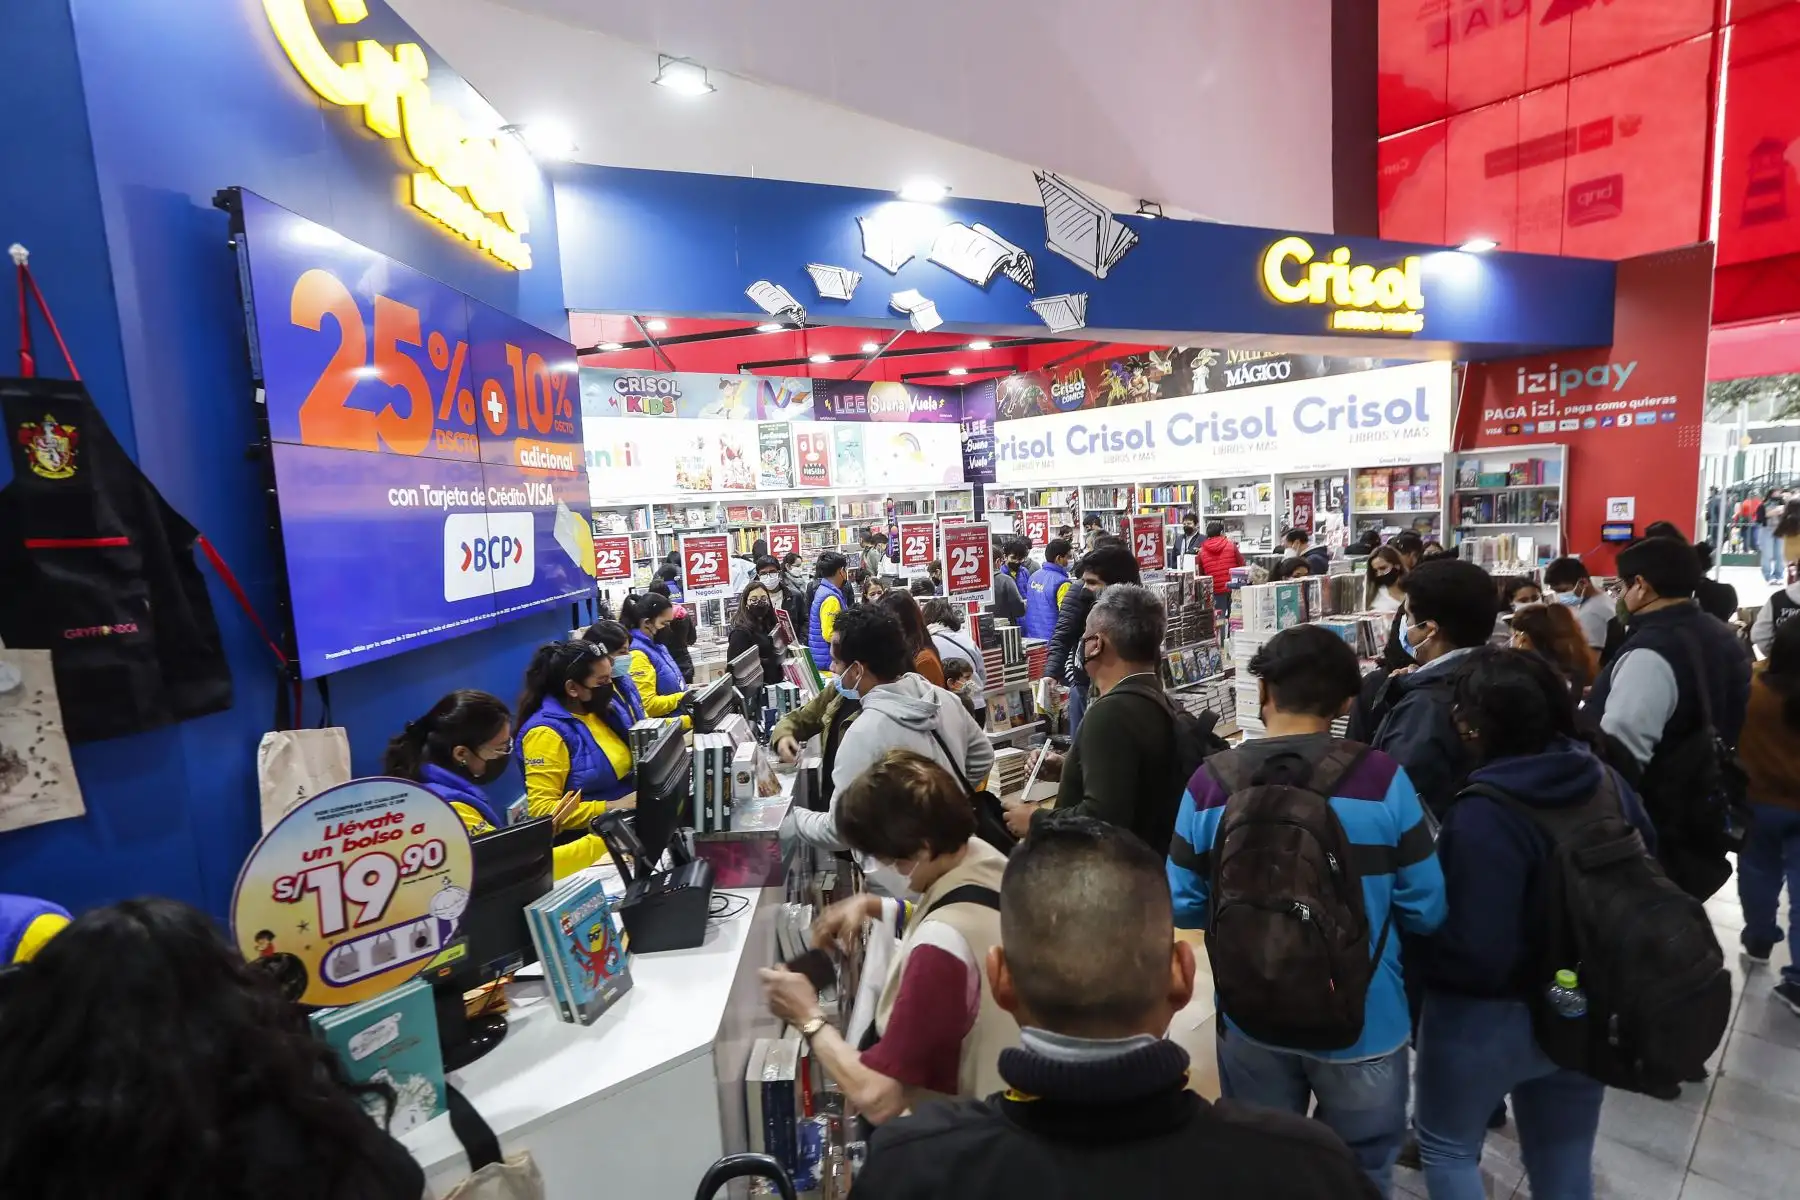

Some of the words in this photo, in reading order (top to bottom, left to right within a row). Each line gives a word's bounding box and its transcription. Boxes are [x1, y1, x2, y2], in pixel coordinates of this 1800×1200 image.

[1262, 236, 1425, 310] Crisol
[290, 269, 476, 456] 25%
[1224, 360, 1291, 387] MÁGICO
[505, 342, 573, 435] 10%
[614, 377, 682, 397] CRISOL
[1051, 378, 1085, 397] Crisol
[1517, 361, 1638, 397] izipay
[626, 395, 675, 416] KIDS
[1293, 386, 1430, 434] Crisol
[1484, 406, 1528, 421] PAGA
[1564, 402, 1593, 416] paga
[1595, 400, 1627, 411] como
[1629, 394, 1678, 409] quieras
[1066, 420, 1156, 456] Crisol
[1166, 405, 1277, 447] Crisol
[1349, 429, 1390, 444] LIBROS
[1392, 429, 1400, 440] Y
[1485, 427, 1502, 436] VISA
[520, 444, 574, 471] adicional
[1213, 443, 1247, 456] LIBROS
[1248, 443, 1256, 453] Y
[388, 487, 419, 506] con
[419, 484, 469, 511] Tarjeta
[470, 487, 486, 506] de
[487, 487, 526, 506] Crédito
[524, 482, 555, 506] VISA
[474, 535, 513, 572] BCP
[323, 810, 406, 841] Llévate
[302, 845, 334, 863] un
[341, 828, 404, 854] bolso
[410, 821, 426, 836] a
